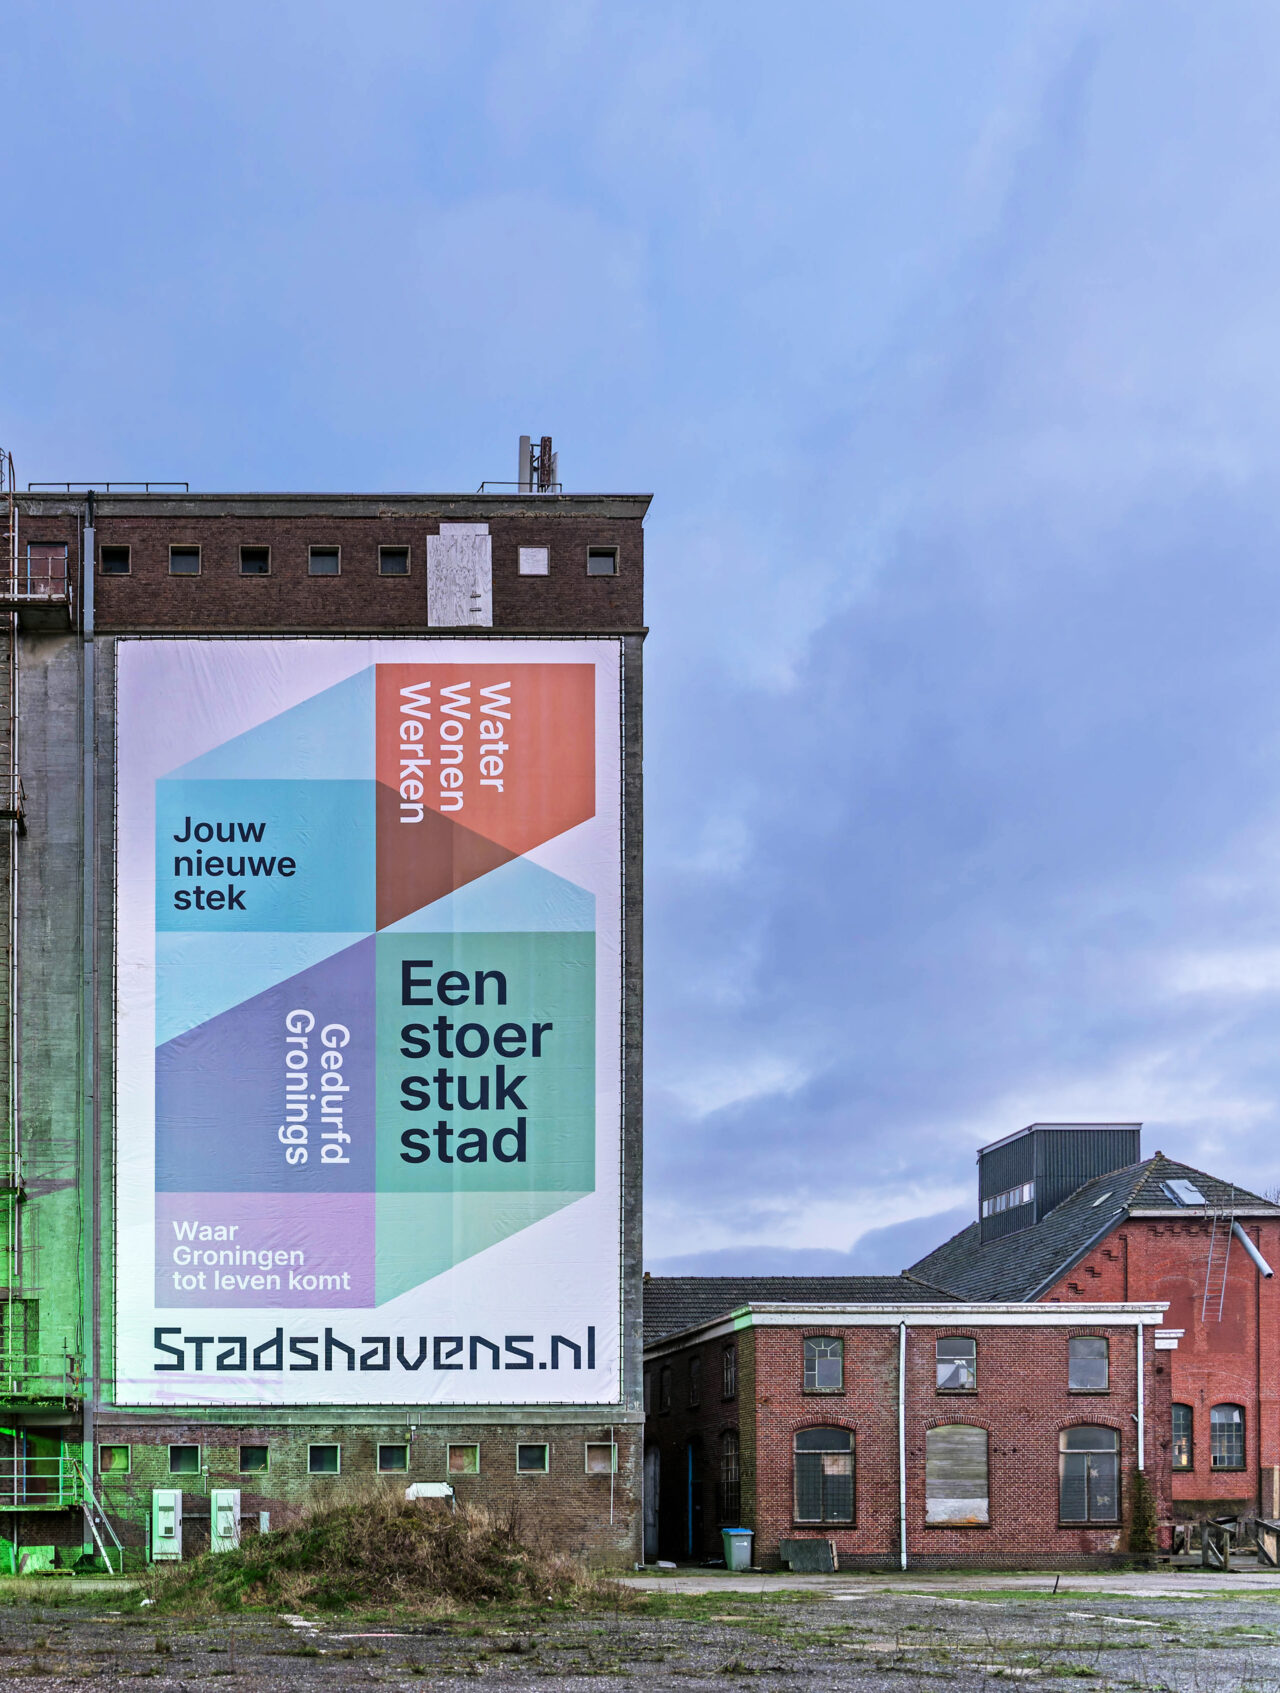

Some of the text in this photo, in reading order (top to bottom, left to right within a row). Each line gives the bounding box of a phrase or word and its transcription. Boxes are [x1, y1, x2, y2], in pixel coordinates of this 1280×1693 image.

[399, 681, 432, 823] Werken
[439, 681, 471, 812] Wonen
[479, 681, 511, 793] Water
[173, 816, 267, 843] Jouw
[174, 849, 297, 878] nieuwe
[173, 883, 247, 911] stek
[401, 959, 507, 1007] Een
[399, 1015, 553, 1059] stoer
[277, 1009, 316, 1165] Gronings
[320, 1023, 352, 1164] Gedurfd
[399, 1064, 528, 1112] stuk
[399, 1116, 527, 1164] stad
[172, 1220, 239, 1241] Waar
[172, 1245, 305, 1270] Groningen
[172, 1269, 351, 1291] tot leven komt
[153, 1325, 596, 1371] Stadshavens.nl
